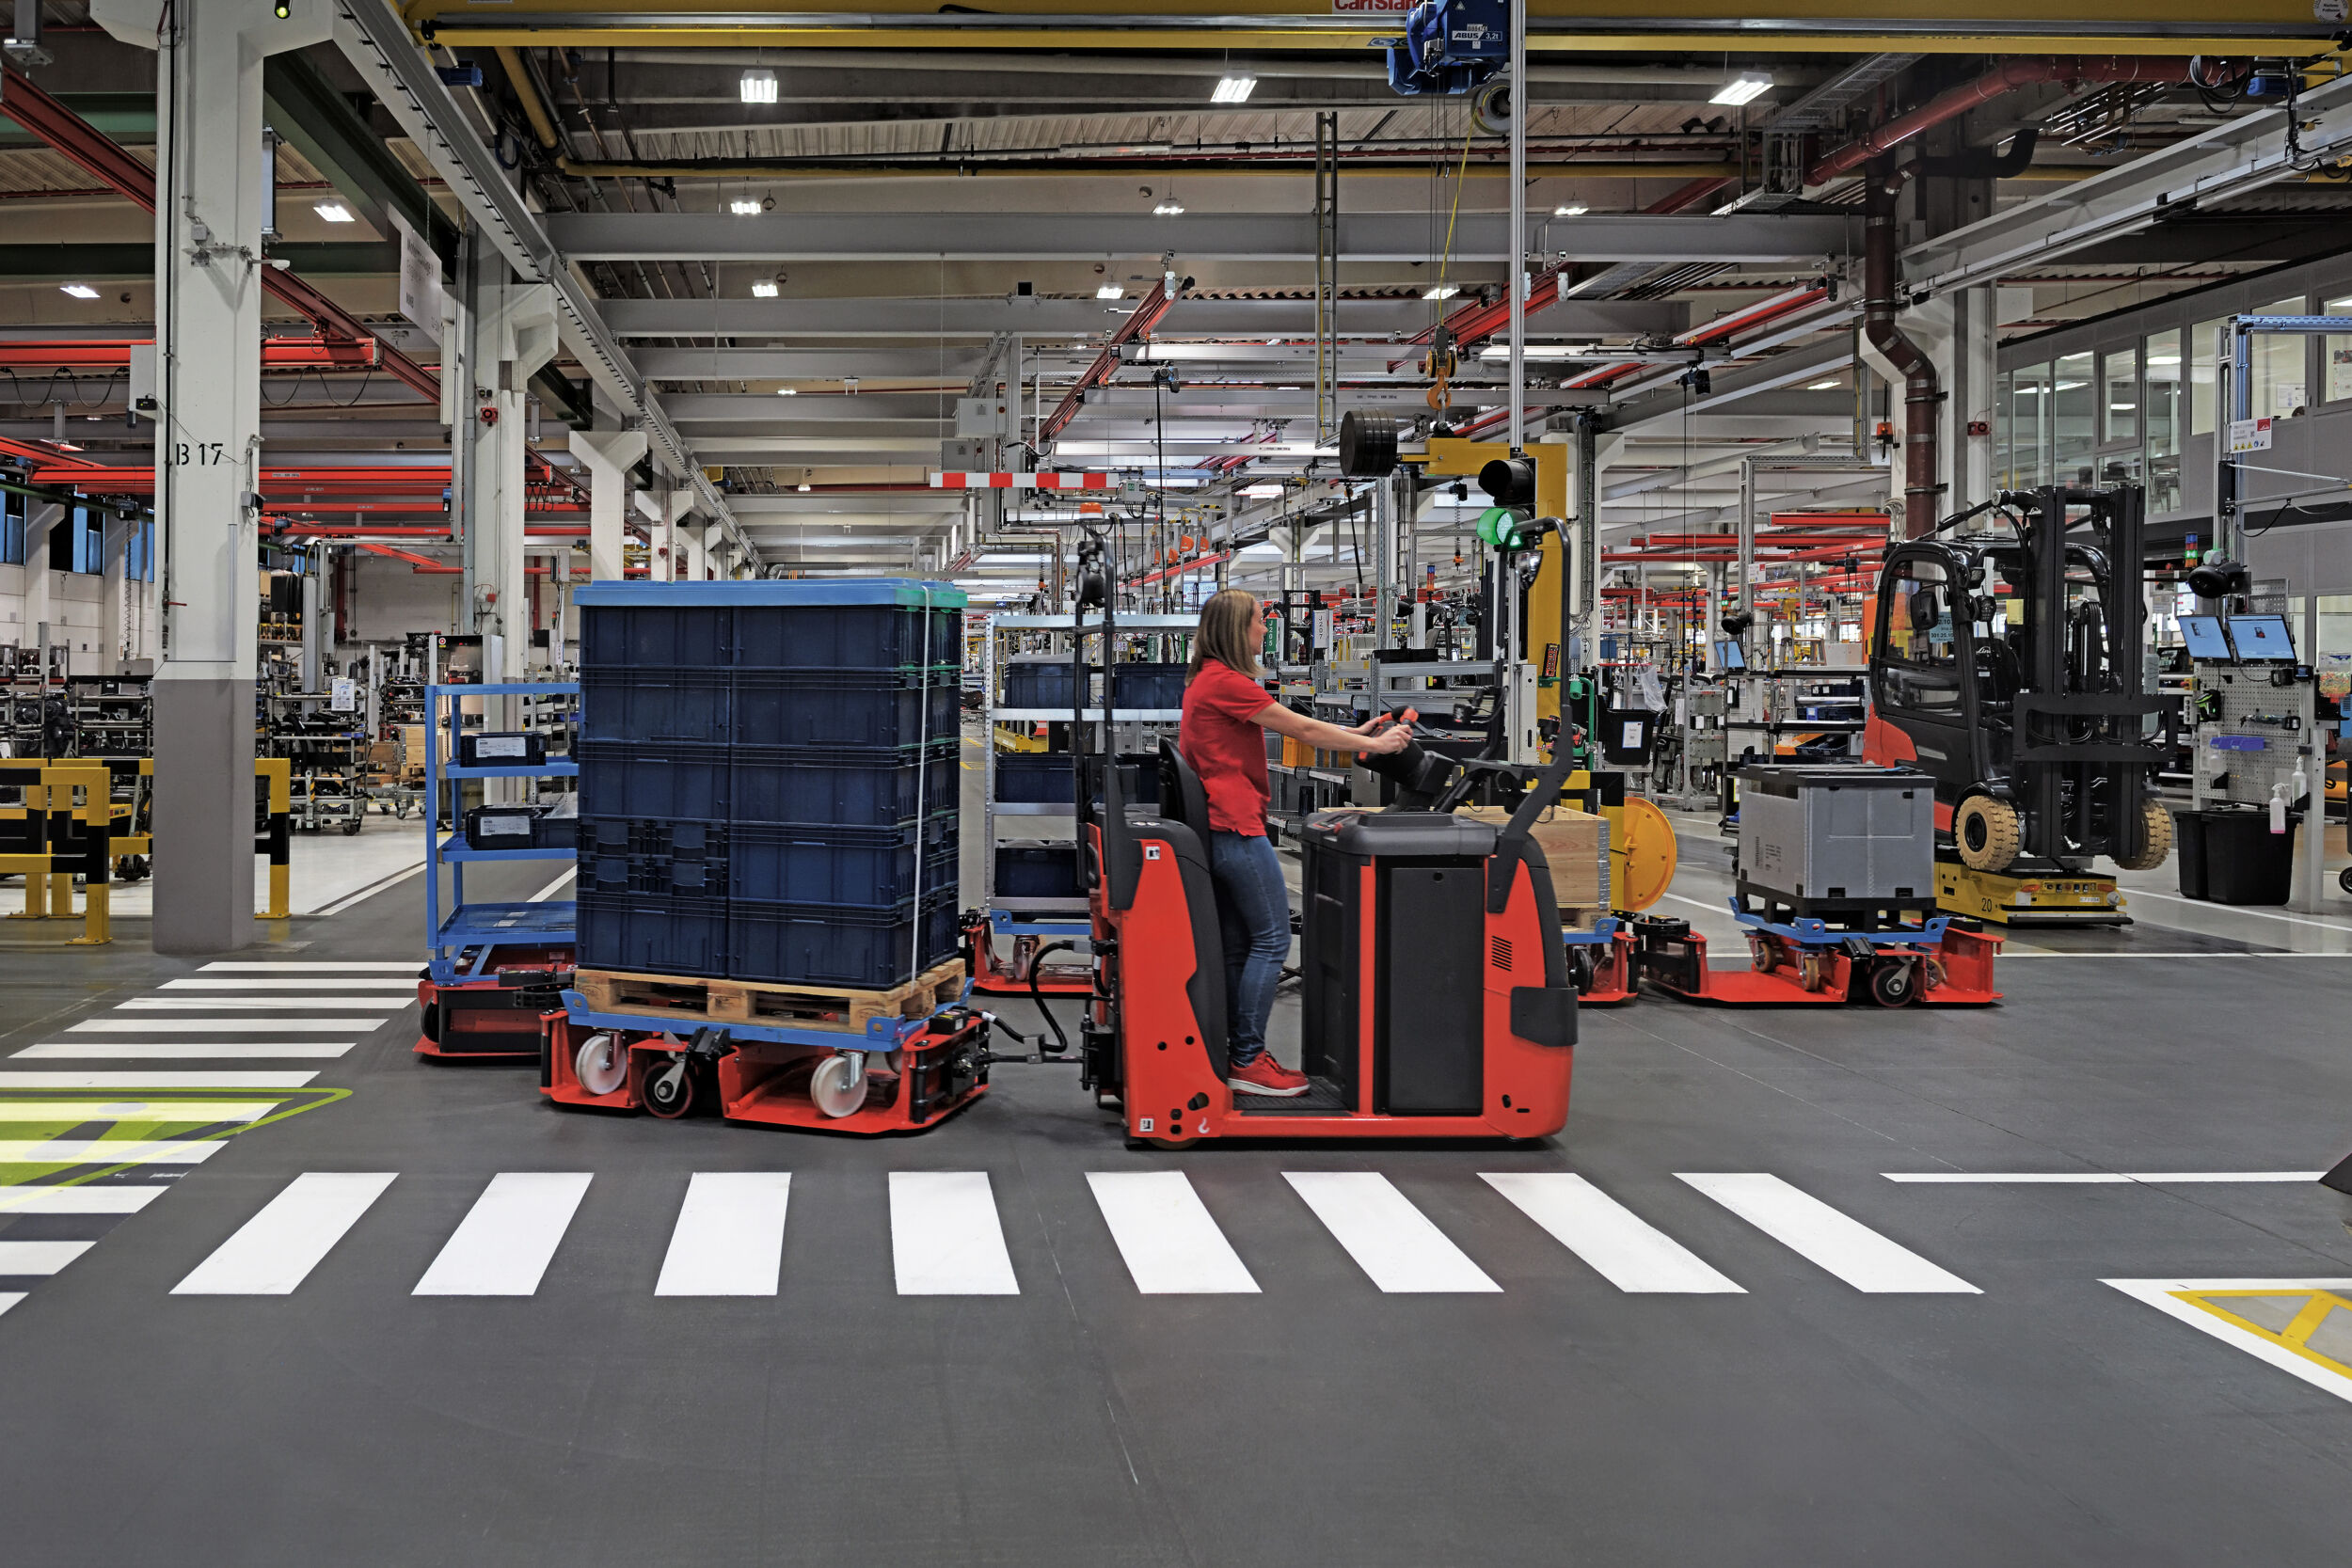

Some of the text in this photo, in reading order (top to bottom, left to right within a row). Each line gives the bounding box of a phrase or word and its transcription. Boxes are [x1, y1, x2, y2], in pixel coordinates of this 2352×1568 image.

[176, 443, 223, 466] B 17
[1981, 897, 1993, 912] 20
